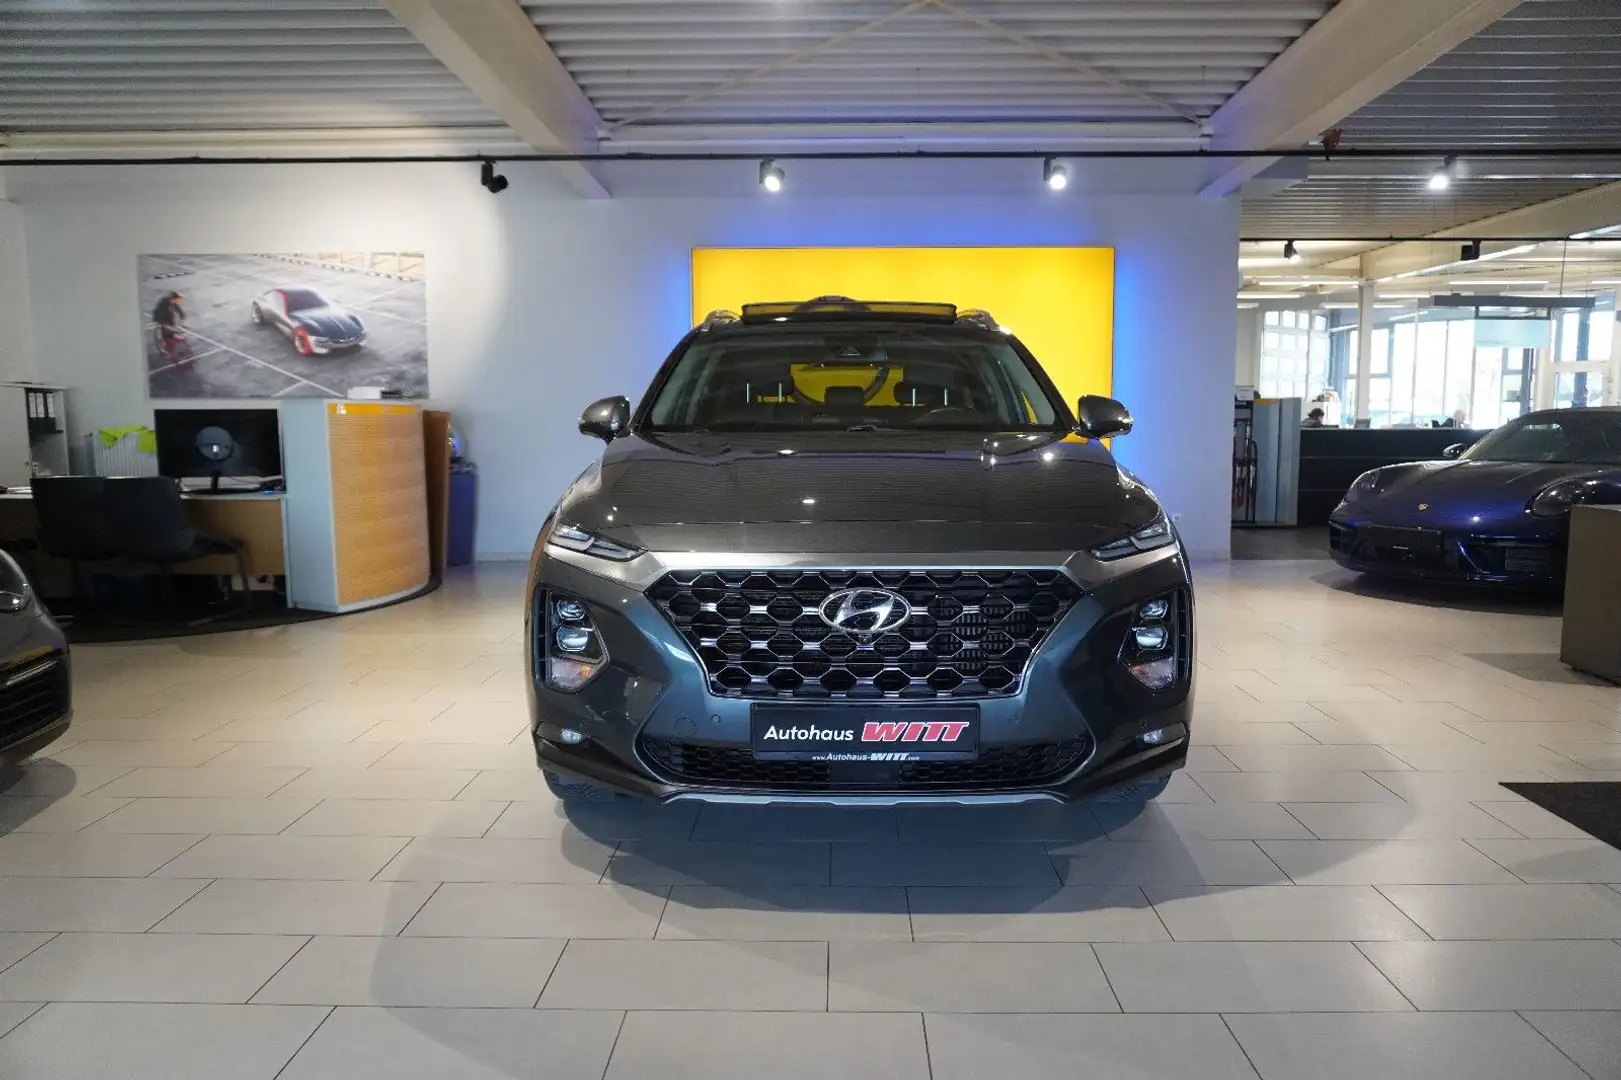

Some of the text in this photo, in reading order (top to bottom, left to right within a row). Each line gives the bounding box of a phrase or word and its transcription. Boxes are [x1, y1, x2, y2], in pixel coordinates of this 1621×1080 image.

[763, 721, 970, 742] Autohaus WITT
[812, 752, 920, 761] www.Autohaus-WITT.com
